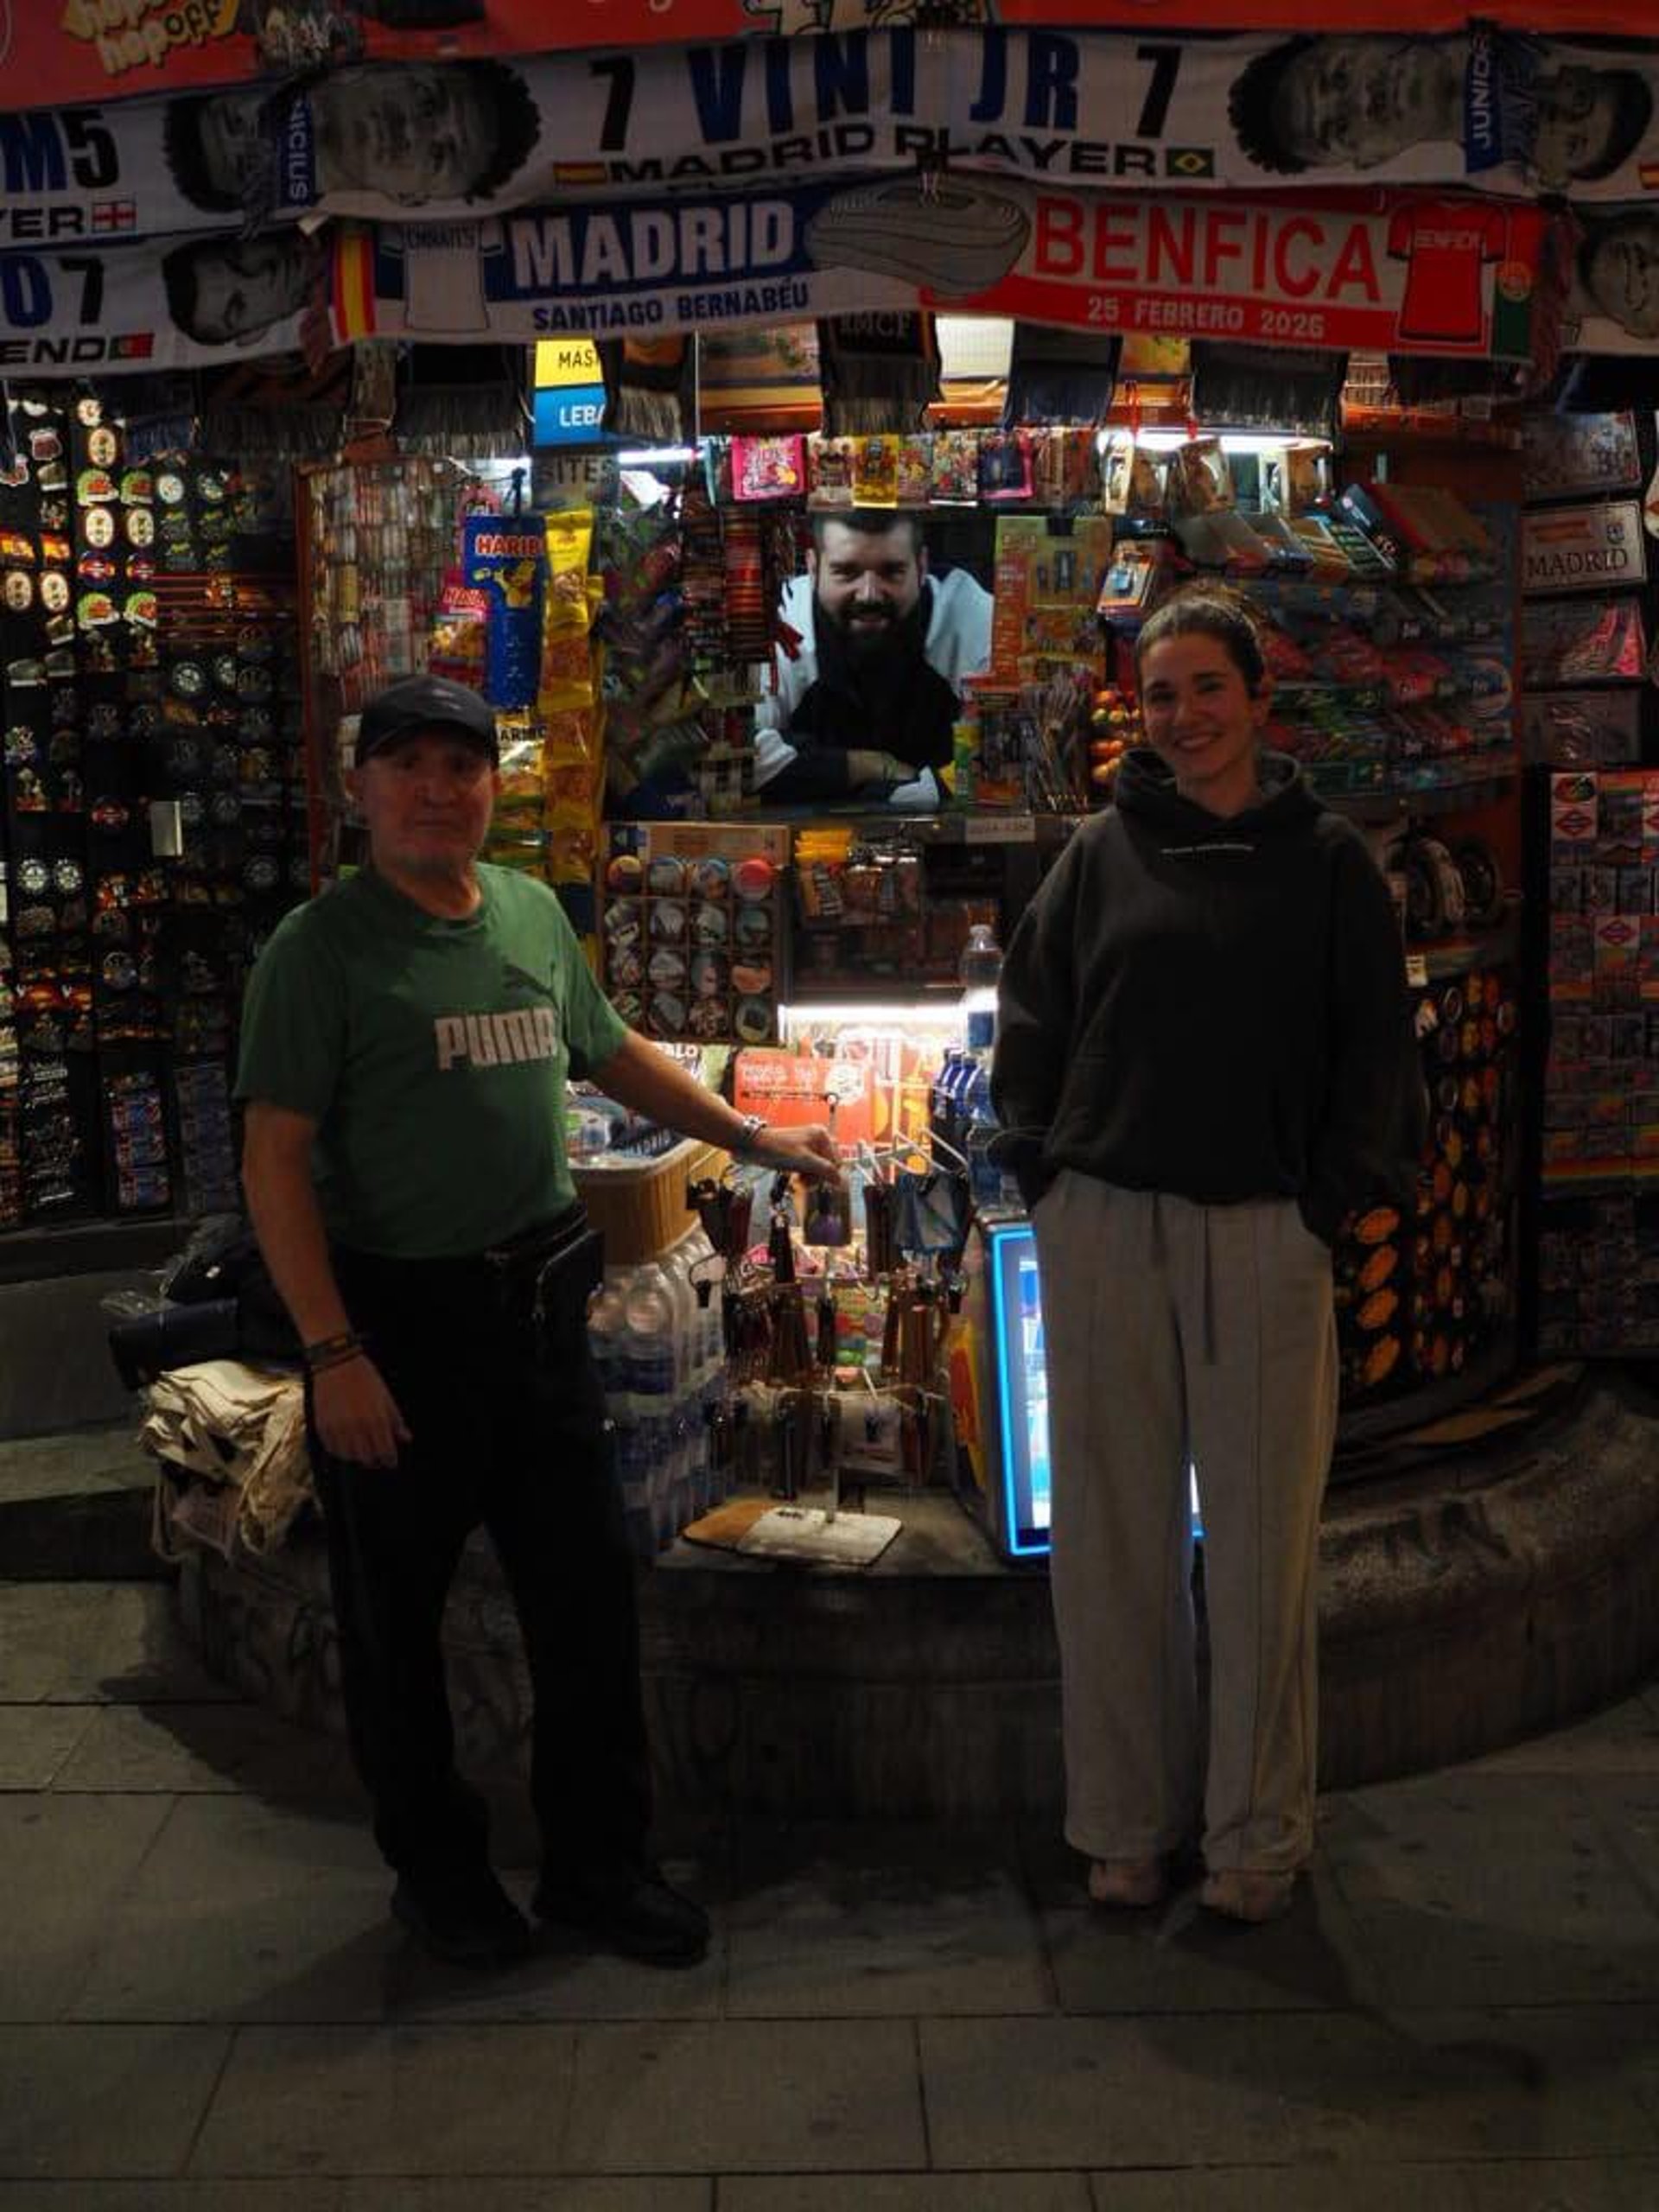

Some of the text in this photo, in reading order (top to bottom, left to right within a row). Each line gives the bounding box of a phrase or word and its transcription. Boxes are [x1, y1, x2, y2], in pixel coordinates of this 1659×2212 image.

[589, 24, 1182, 151] 7 VINI JR 7
[610, 124, 1156, 183] MADRID PLAYER
[0, 207, 84, 239] ER
[512, 196, 1382, 303] MADRID BENFICA
[532, 282, 809, 332] SANTIAGO BERNABÉU
[1087, 295, 1325, 341] 25 FEBRERO 2026
[474, 532, 550, 560] HARIB
[1526, 547, 1628, 579] MADRID
[434, 1007, 556, 1071] PUMA
